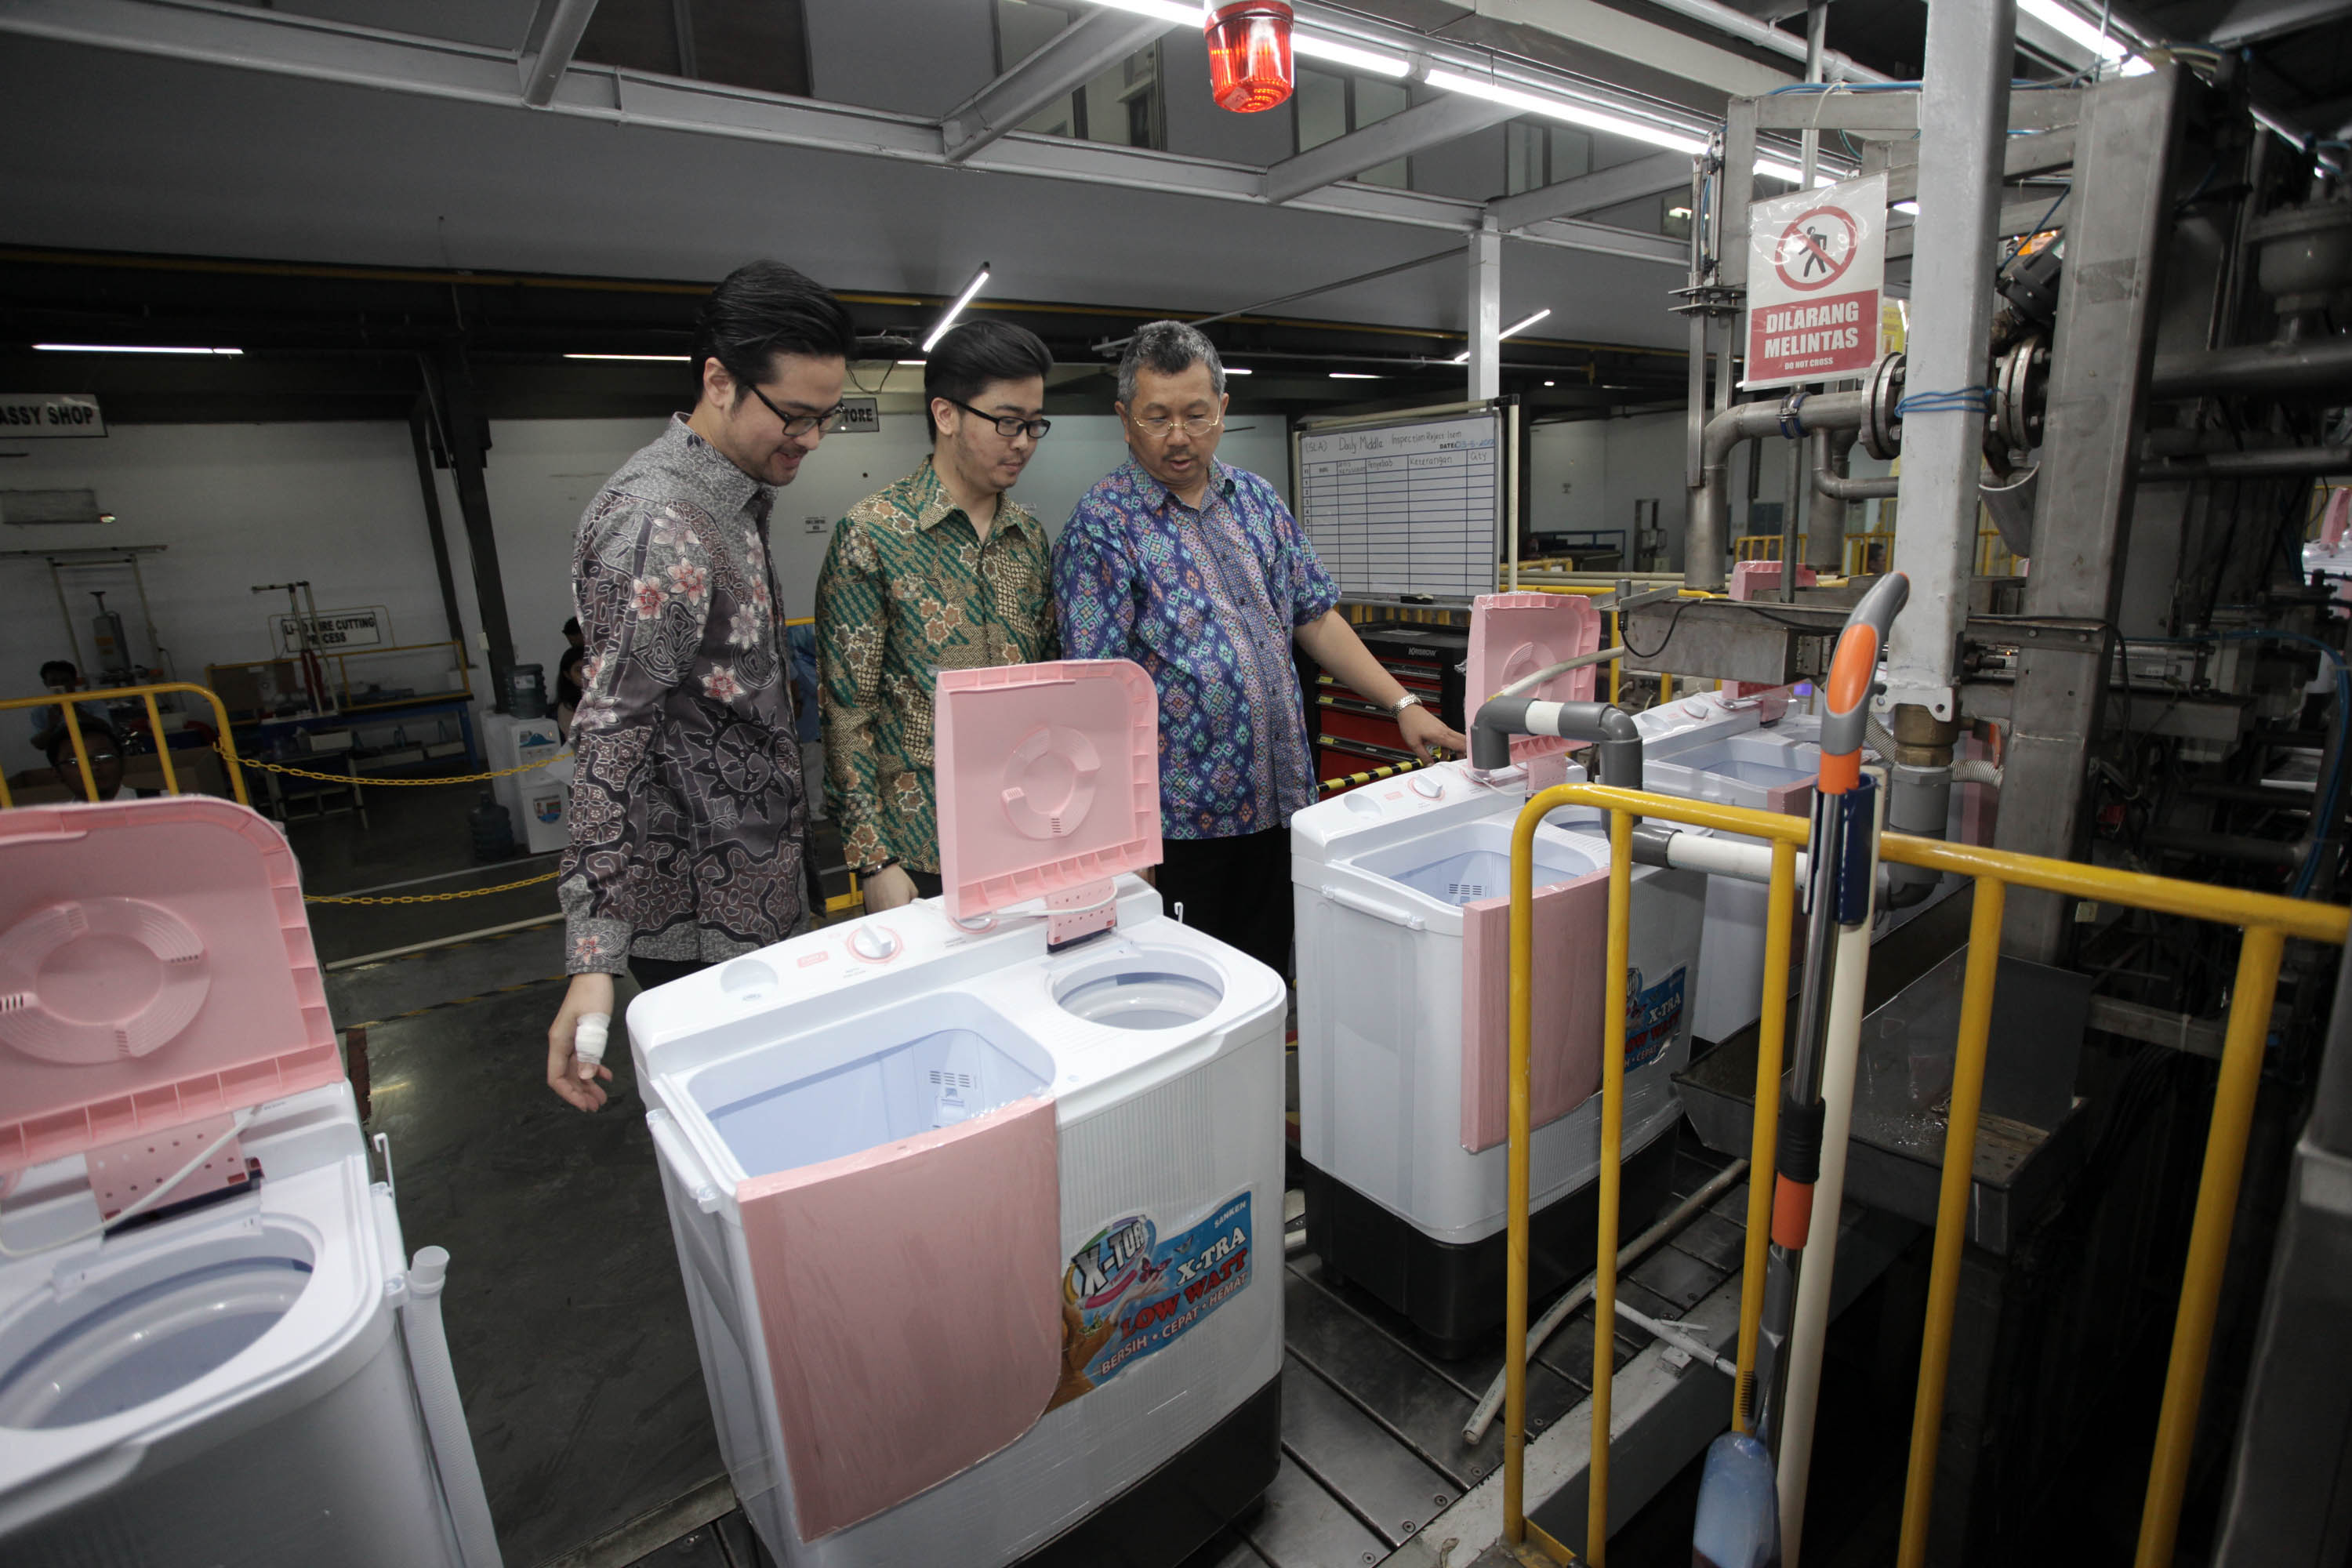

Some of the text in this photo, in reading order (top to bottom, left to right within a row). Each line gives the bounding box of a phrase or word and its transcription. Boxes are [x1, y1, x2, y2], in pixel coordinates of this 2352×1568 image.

[1766, 301, 1859, 334] DILARANG
[1764, 328, 1858, 358] MELINTAS
[1795, 360, 1808, 368] NOT
[1809, 358, 1834, 367] CROSS
[48, 405, 93, 425] SHOP
[1338, 437, 1357, 455] Daily
[1359, 435, 1385, 451] Middle
[1392, 432, 1425, 448] Inspection
[1410, 455, 1453, 466] Keterangan
[336, 616, 376, 630] CUTTING
[307, 632, 347, 644] PRCESS
[1648, 991, 1682, 1025] X-TRA
[1214, 1200, 1247, 1229] SANKEN
[1176, 1226, 1247, 1287] X-TRA
[1120, 1293, 1181, 1342] LOW
[1184, 1247, 1248, 1305] WATT
[1100, 1271, 1249, 1377] BERSIH CEPAT HEMAT
